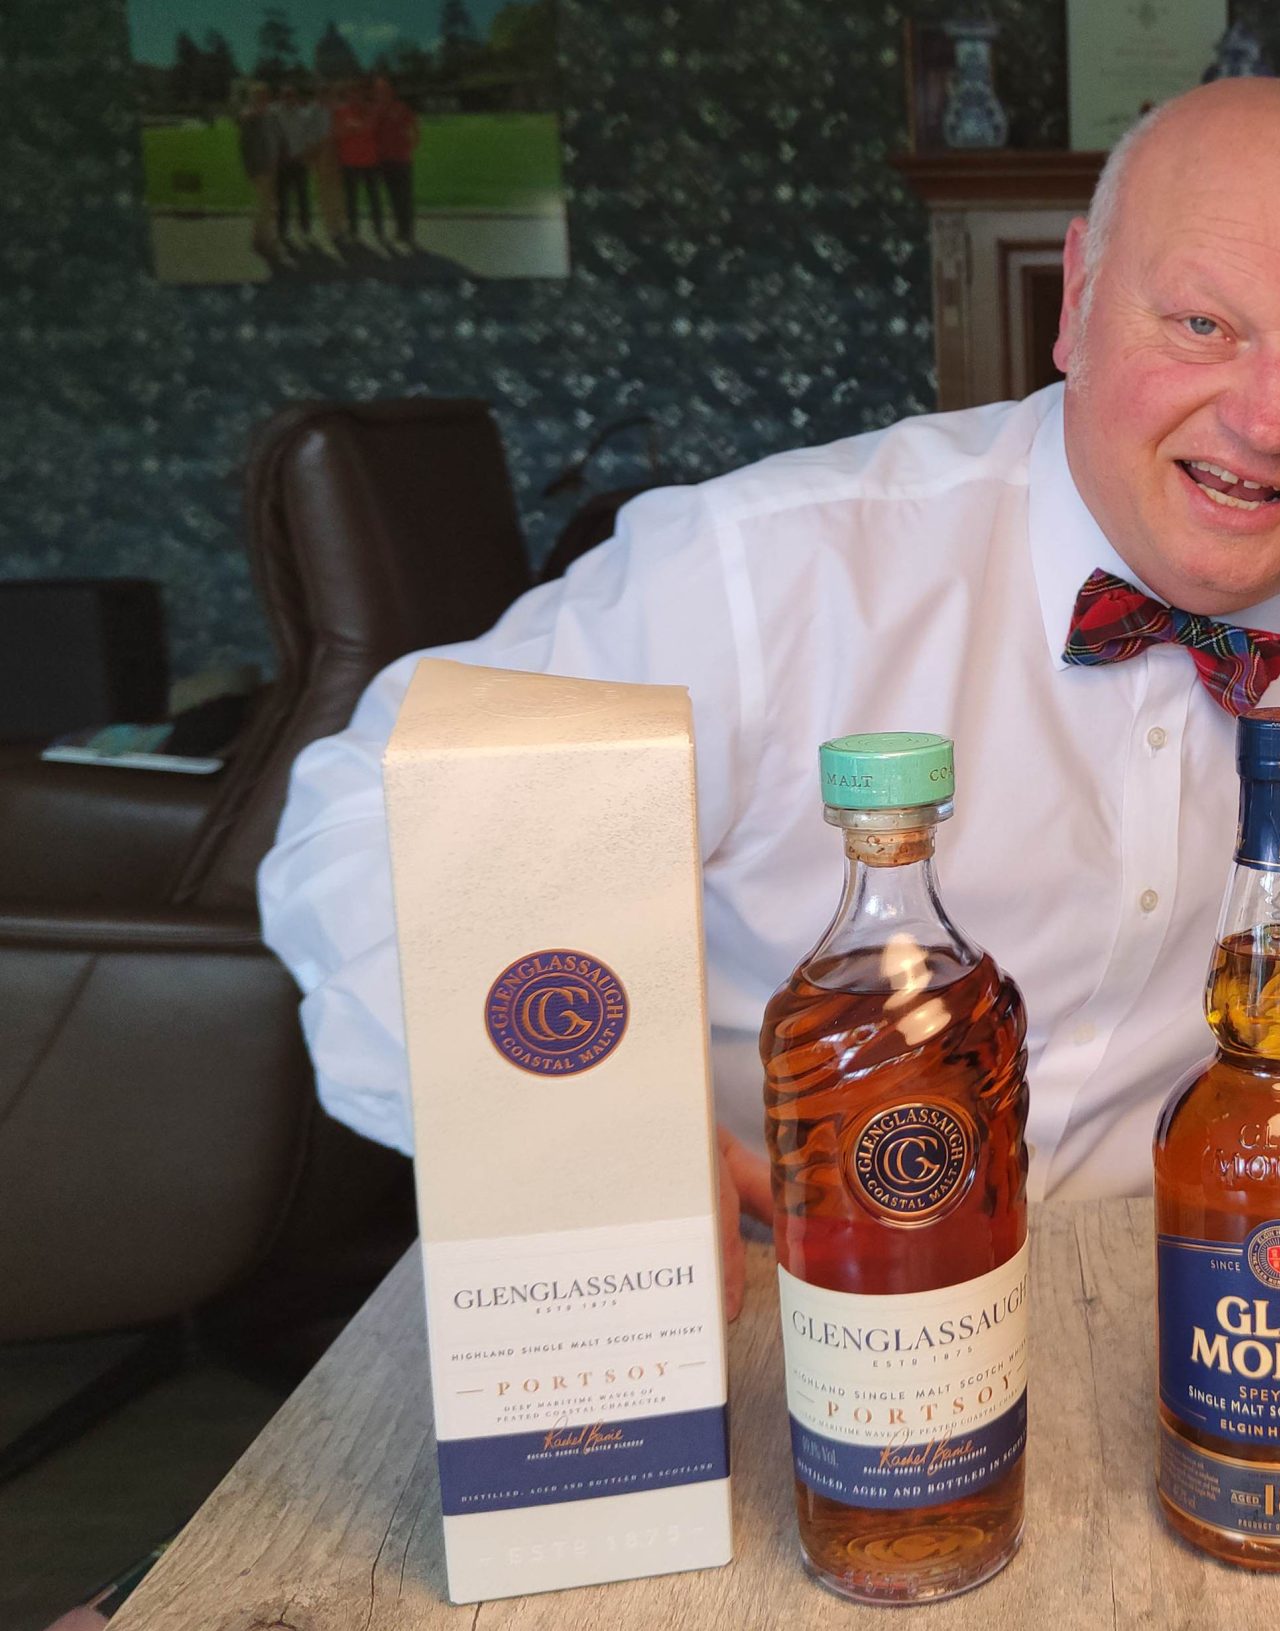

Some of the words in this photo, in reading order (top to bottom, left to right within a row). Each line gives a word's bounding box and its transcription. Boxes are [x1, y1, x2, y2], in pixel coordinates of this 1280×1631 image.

[827, 772, 873, 788] MALT
[491, 955, 624, 1029] GLENGLASSAUGH
[502, 1037, 575, 1070] COASTAL
[578, 1027, 616, 1063] MALT
[857, 1108, 963, 1173] GLENGLASSAUGH
[867, 1179, 926, 1209] COASTAL
[929, 1168, 957, 1201] MALT
[1210, 1259, 1241, 1272] SINCE
[453, 1265, 694, 1310] GLENGLASSAUGH
[583, 1299, 617, 1309] 1875
[791, 1273, 1028, 1353] GLENGLASSAUGH
[451, 1348, 515, 1361] HIGHLAND
[522, 1342, 563, 1355] SINGLE
[570, 1338, 600, 1349] MALT
[607, 1332, 653, 1345] SCOTCH
[660, 1325, 703, 1338] WHISKY
[932, 1346, 973, 1364] 1875
[497, 1360, 668, 1396] PORTSOY
[793, 1368, 845, 1397] HIGHLAND
[854, 1390, 905, 1401] SINGLE
[915, 1384, 951, 1399] MALT
[960, 1361, 1004, 1389] SCOTCH
[828, 1370, 1012, 1425] PORTSOY
[1188, 1384, 1226, 1409] SINGLE
[1231, 1399, 1264, 1416] MALT
[1220, 1418, 1264, 1436] ELGIN
[659, 1463, 713, 1477] SCOTLAND
[852, 1480, 887, 1498] AGED
[893, 1485, 921, 1497] AND
[927, 1467, 986, 1495] BOTTLED
[990, 1457, 1000, 1472] IN
[1231, 1492, 1260, 1505] AGED
[1238, 1518, 1272, 1531] PRODUCT
